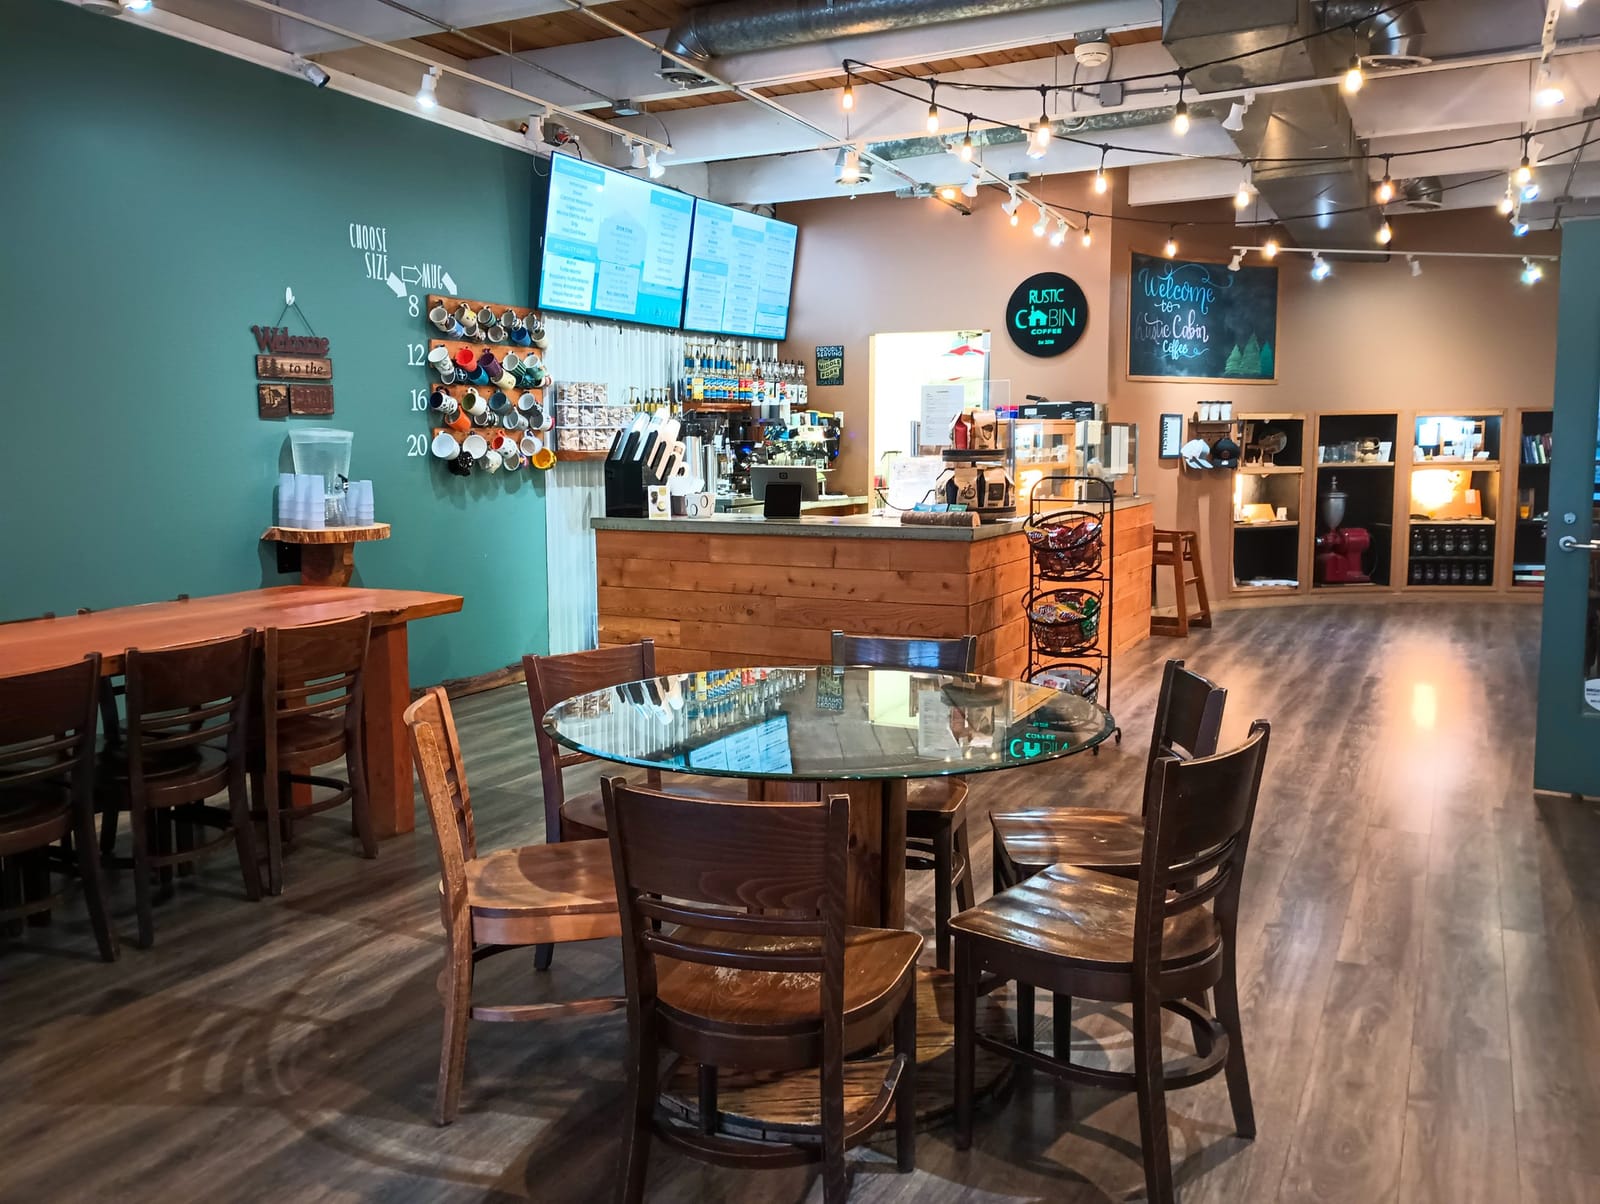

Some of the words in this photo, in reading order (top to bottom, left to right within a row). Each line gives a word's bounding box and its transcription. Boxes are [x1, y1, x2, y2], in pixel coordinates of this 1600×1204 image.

[349, 223, 388, 252] CHOOSE
[365, 251, 389, 280] SIZE
[422, 263, 443, 290] MUG
[1028, 288, 1065, 304] RUSTIC
[1138, 264, 1215, 314] Welcome
[408, 295, 419, 317] 8
[1154, 300, 1180, 313] to
[1172, 309, 1209, 342] Cabin
[407, 344, 425, 366] 12
[1162, 338, 1189, 360] Coffee
[289, 363, 301, 373] to
[305, 362, 325, 375] the
[818, 359, 841, 369] MIDDLE
[410, 389, 428, 411] 16
[407, 434, 428, 457] 20
